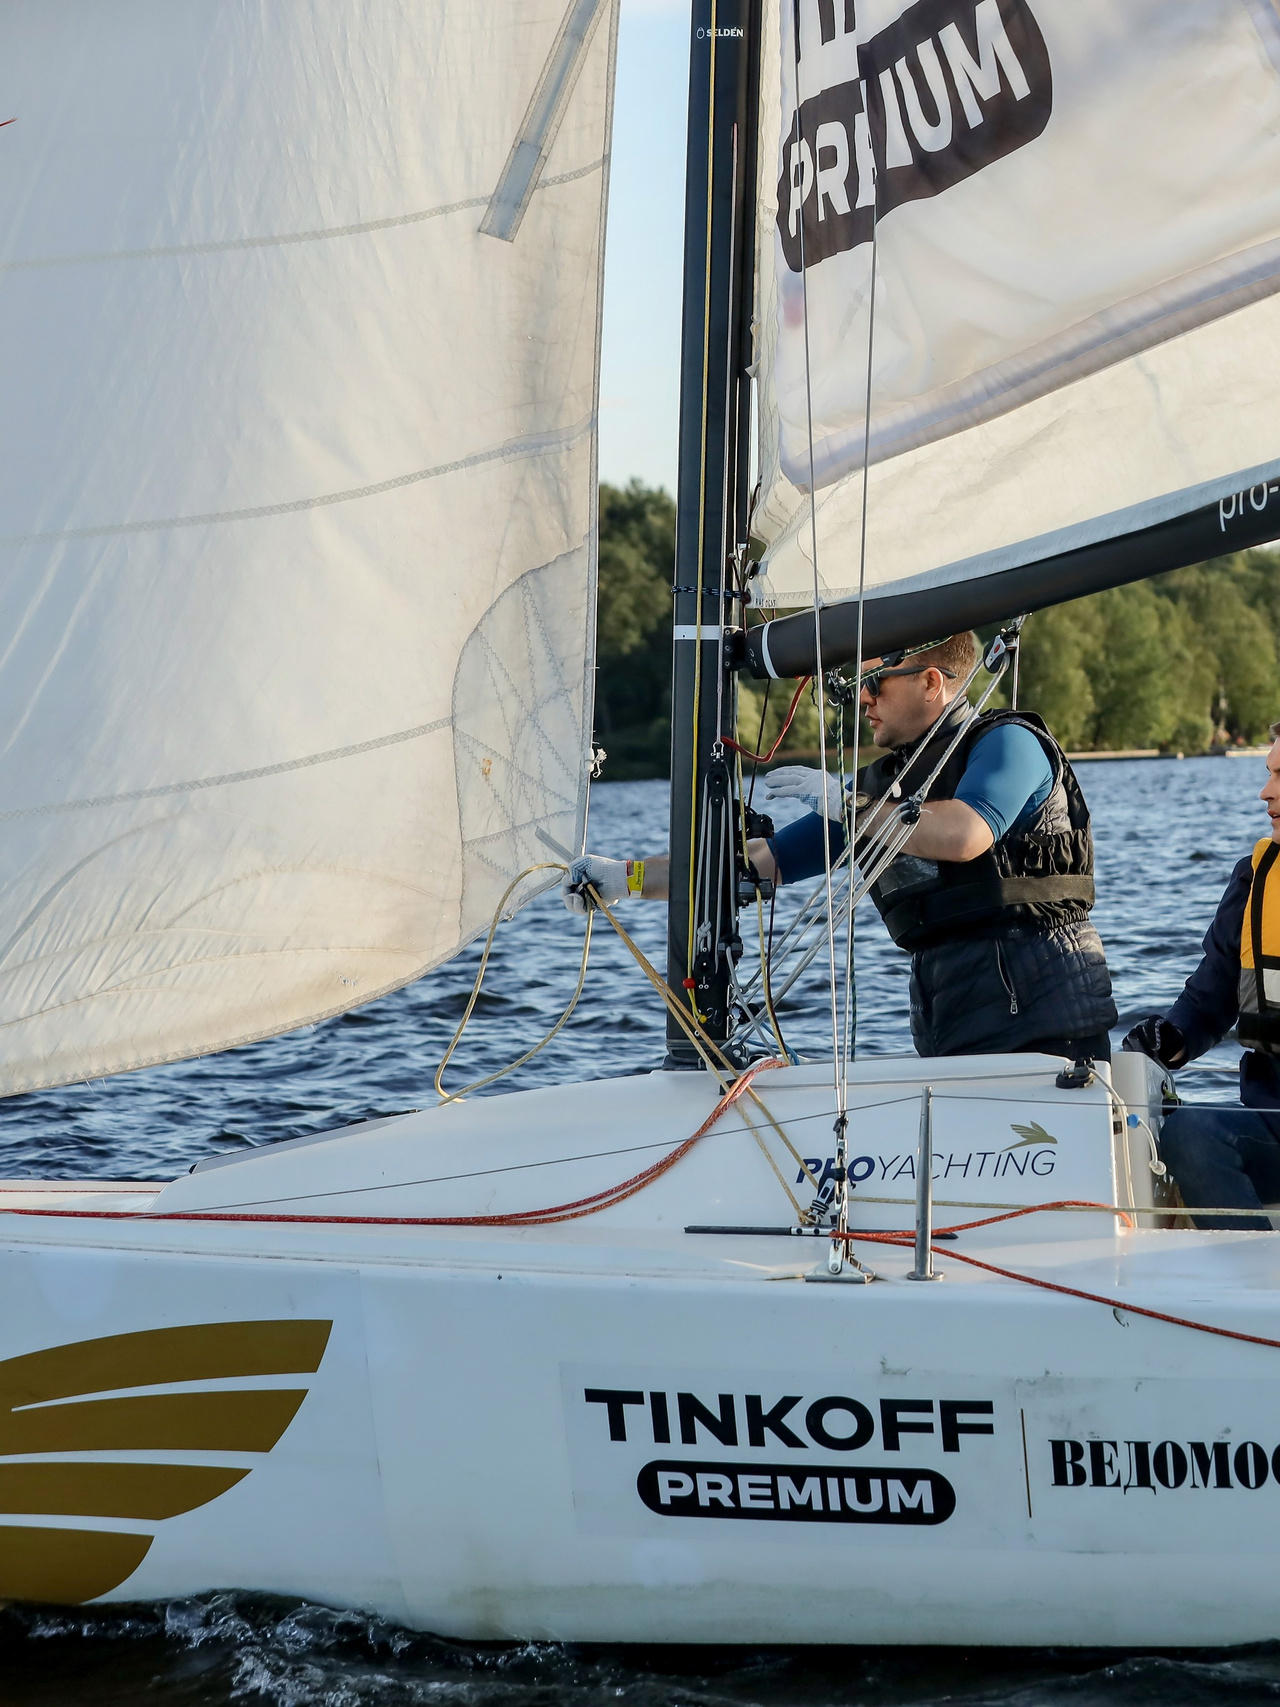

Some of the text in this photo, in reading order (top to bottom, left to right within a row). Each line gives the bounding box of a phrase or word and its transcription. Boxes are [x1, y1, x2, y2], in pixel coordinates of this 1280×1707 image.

[787, 0, 1032, 239] PREIUM
[584, 1388, 995, 1453] TINKOFF
[656, 1470, 935, 1514] PREMIUM
